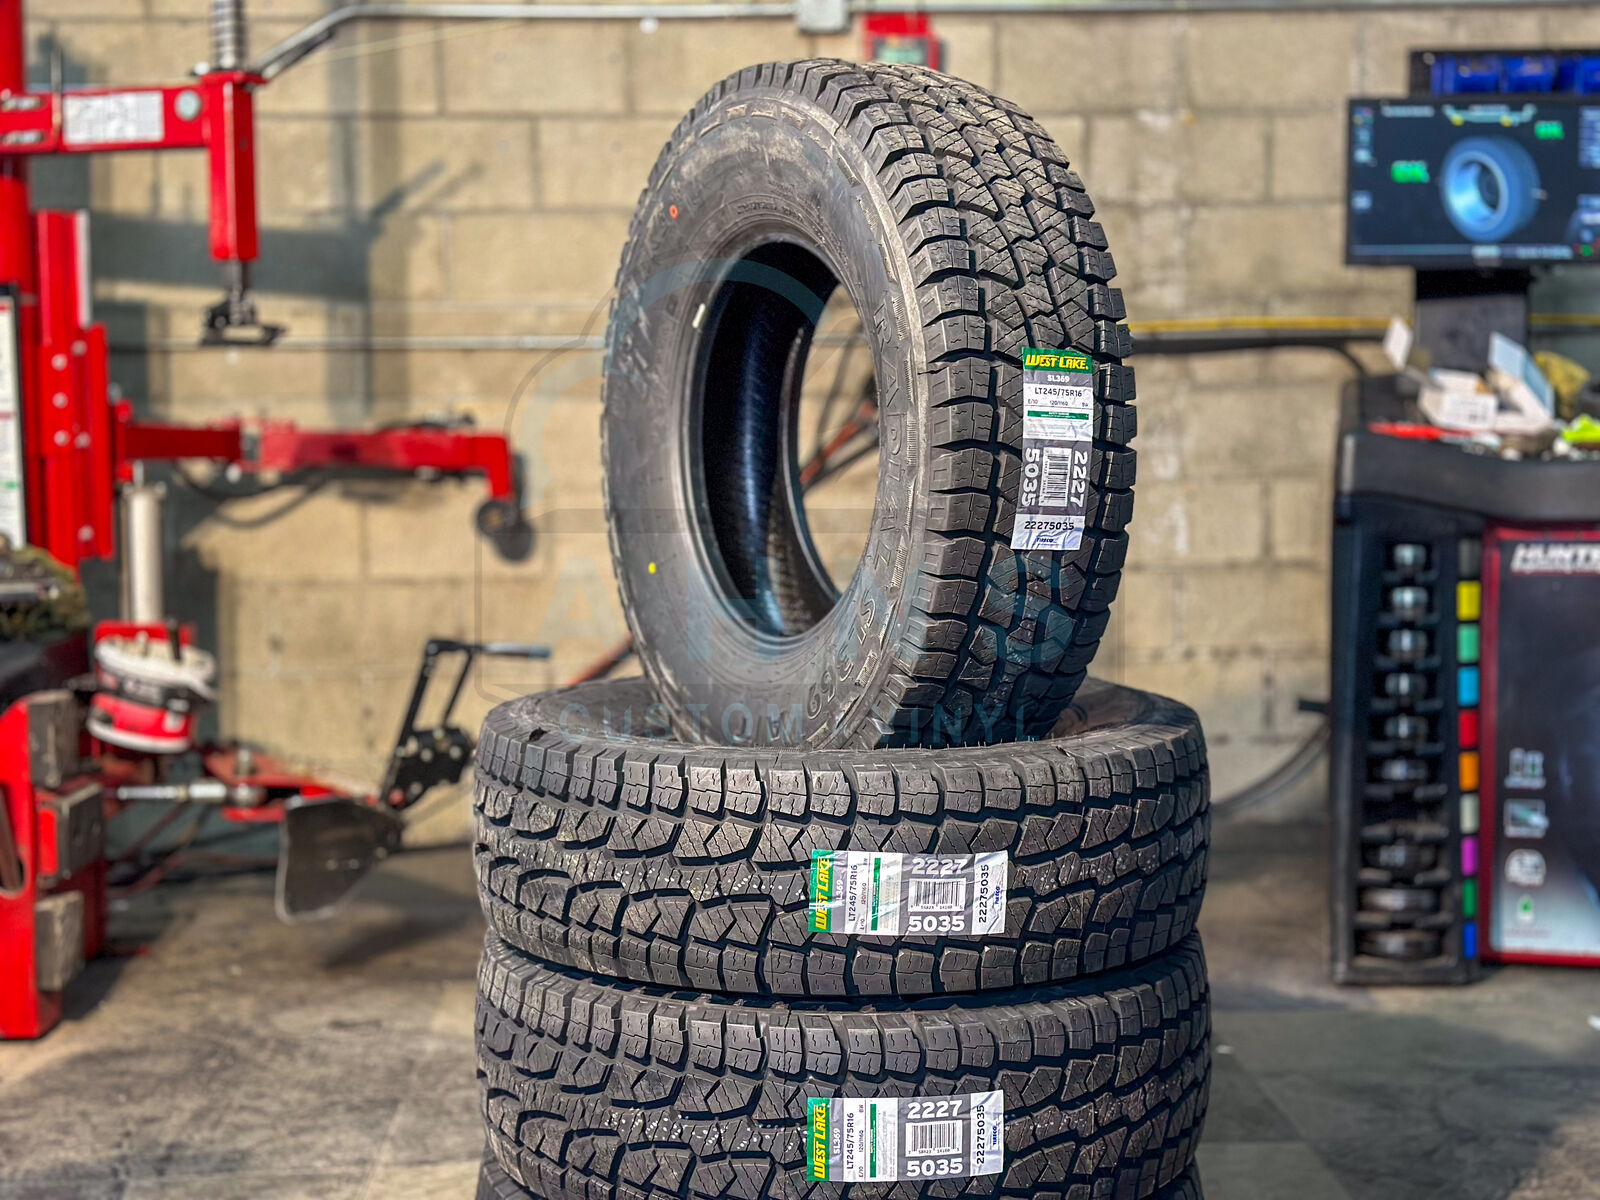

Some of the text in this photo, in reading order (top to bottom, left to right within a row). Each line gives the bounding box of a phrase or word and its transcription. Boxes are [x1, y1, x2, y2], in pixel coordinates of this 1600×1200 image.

[1025, 354, 1088, 370] WEST LAKE
[1034, 387, 1083, 397] LT245/75R16
[1047, 374, 1070, 383] SL369
[1021, 448, 1040, 506] 5035
[1070, 451, 1088, 507] 2227
[1024, 521, 1075, 530] 22275035
[816, 856, 830, 892] LAKE
[911, 858, 968, 875] 2227
[848, 865, 858, 921] LT245/75R16
[979, 864, 989, 923] 22275035
[908, 915, 965, 932] 5035
[907, 1100, 963, 1119] 2227
[813, 1104, 826, 1179] WEST LAKE
[833, 1127, 841, 1155] SL369
[846, 1112, 855, 1170] LT245/75R16
[976, 1104, 985, 1165] 22275035
[906, 1157, 963, 1177] 5035
